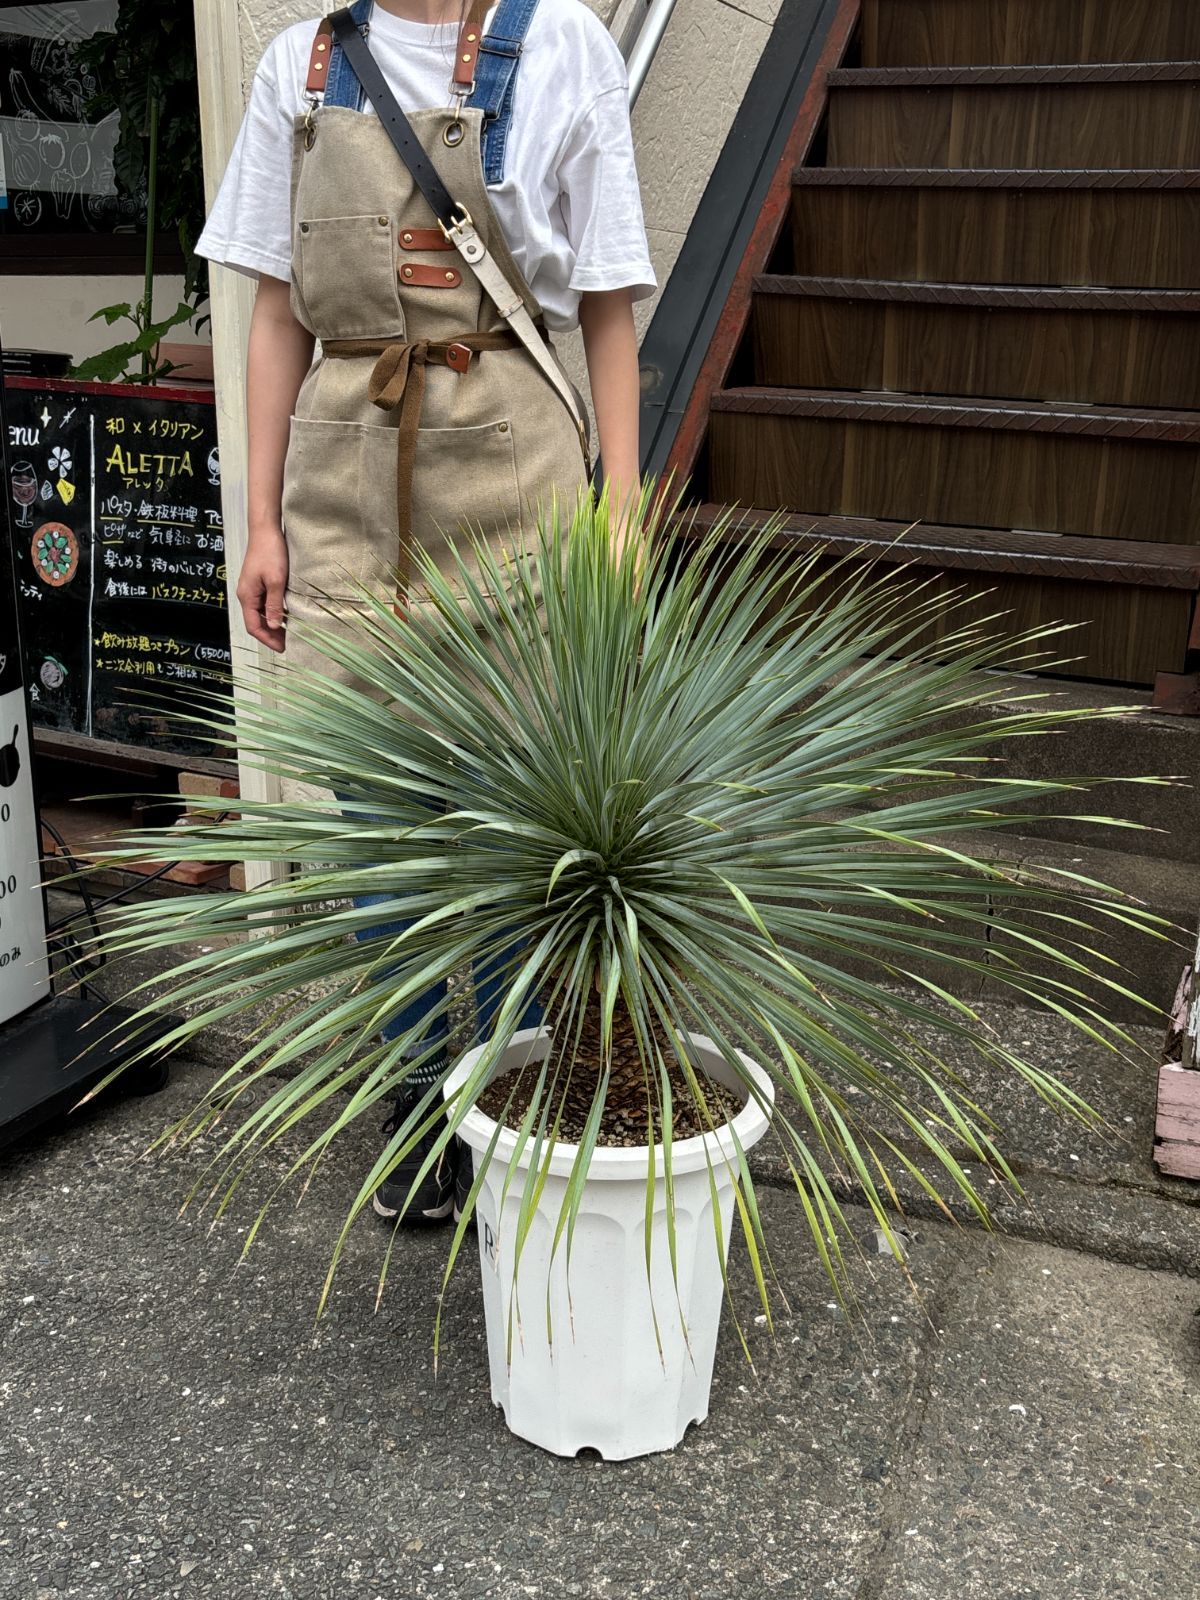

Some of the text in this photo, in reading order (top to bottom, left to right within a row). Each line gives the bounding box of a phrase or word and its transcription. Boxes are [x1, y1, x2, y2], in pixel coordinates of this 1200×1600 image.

[149, 419, 204, 440] イタリアン
[105, 444, 194, 478] ALETTA
[122, 476, 164, 493] アレッタ
[149, 525, 191, 545] 気軽に
[195, 533, 224, 551] お酒
[104, 548, 143, 569] 楽しめる
